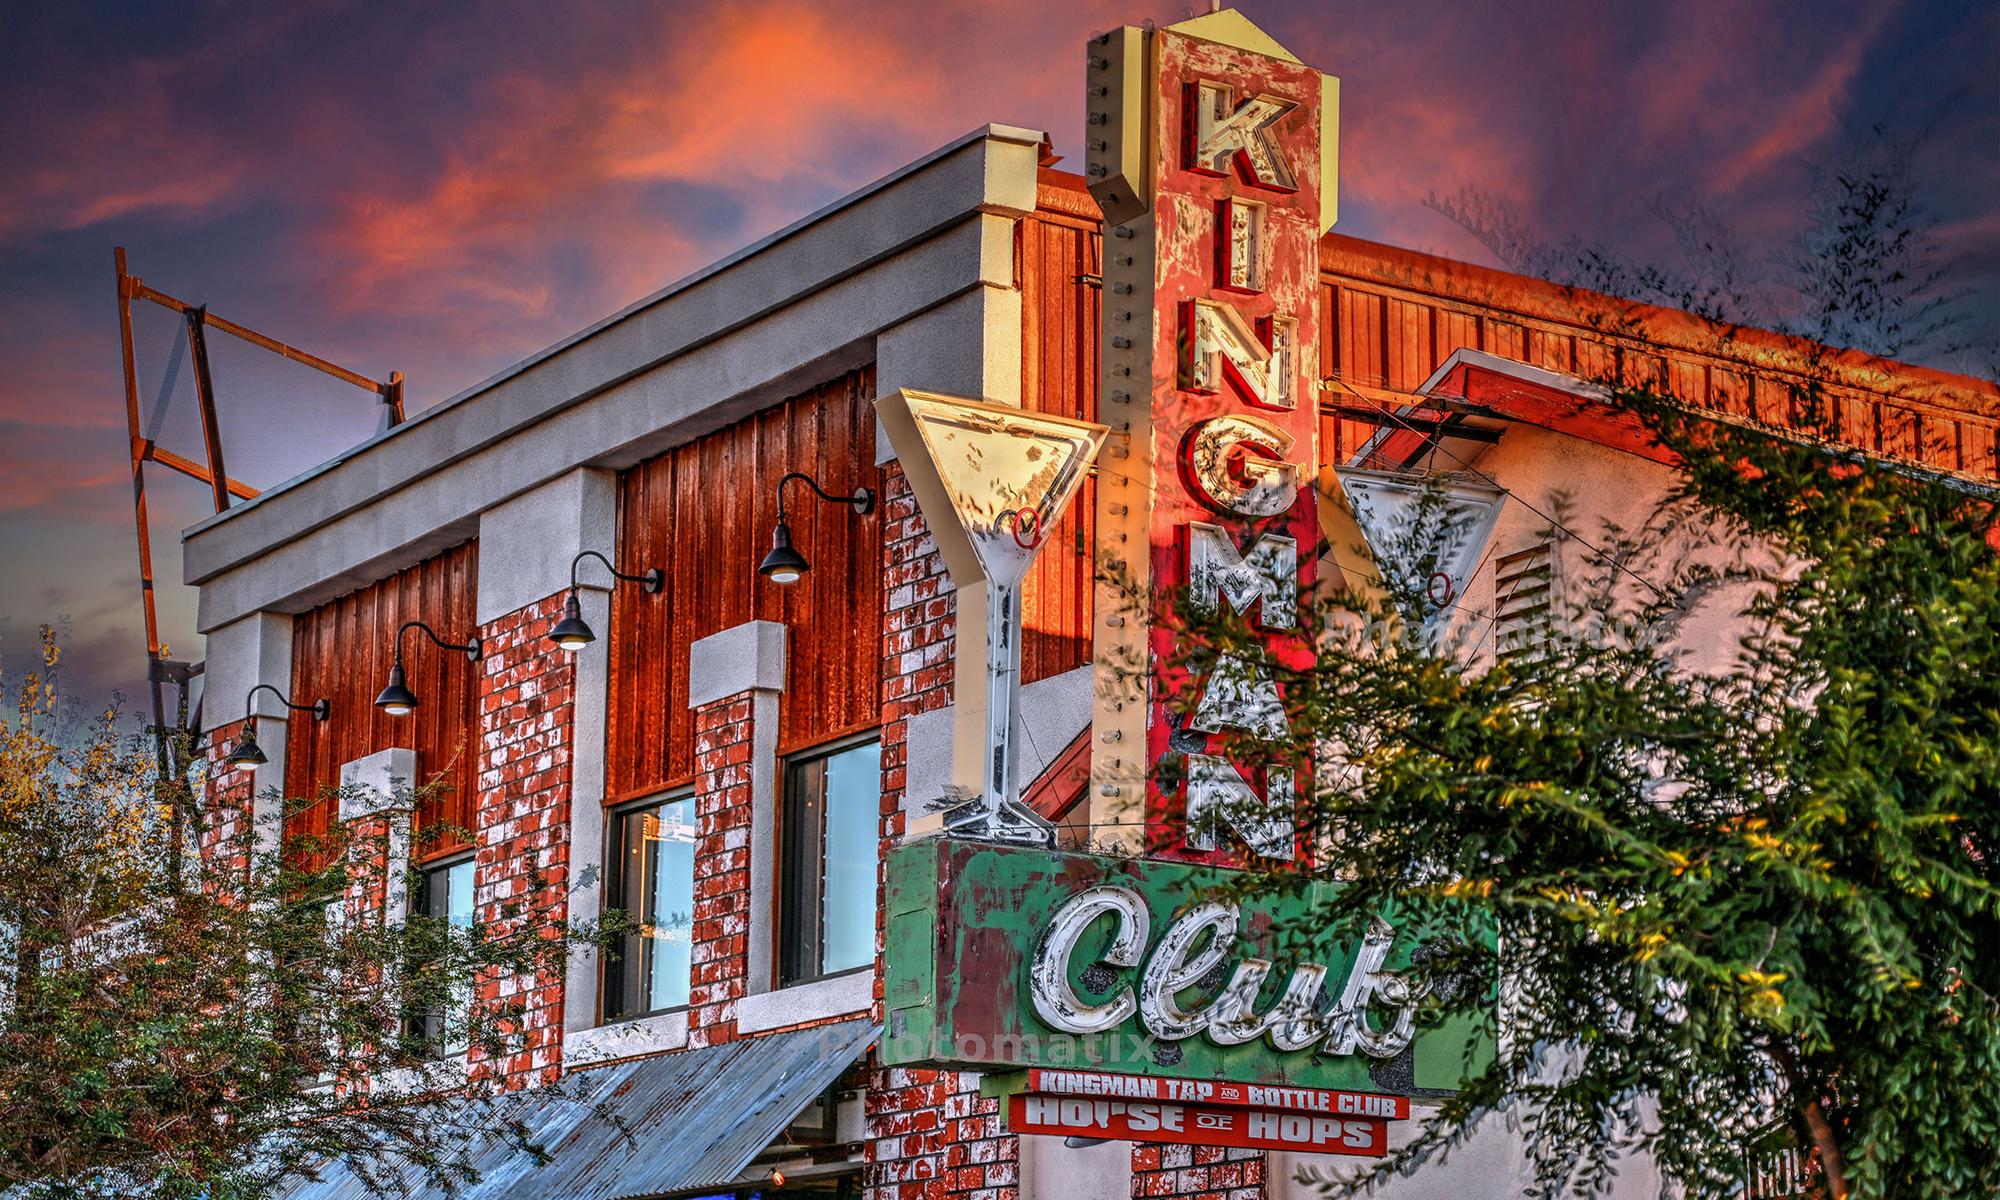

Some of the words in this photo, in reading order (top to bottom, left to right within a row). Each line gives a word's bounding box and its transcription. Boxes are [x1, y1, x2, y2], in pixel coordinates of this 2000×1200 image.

[1176, 78, 1300, 862] KINGMAN
[1031, 886, 1432, 1058] Club
[1040, 1071, 1158, 1098] KINGMAN
[1166, 1080, 1213, 1102] TAP
[1221, 1089, 1240, 1098] AND
[1248, 1086, 1330, 1112] BOTTLE
[1338, 1094, 1397, 1117] CLUB
[1197, 1115, 1232, 1127] OF
[1248, 1112, 1373, 1148] HOPS
